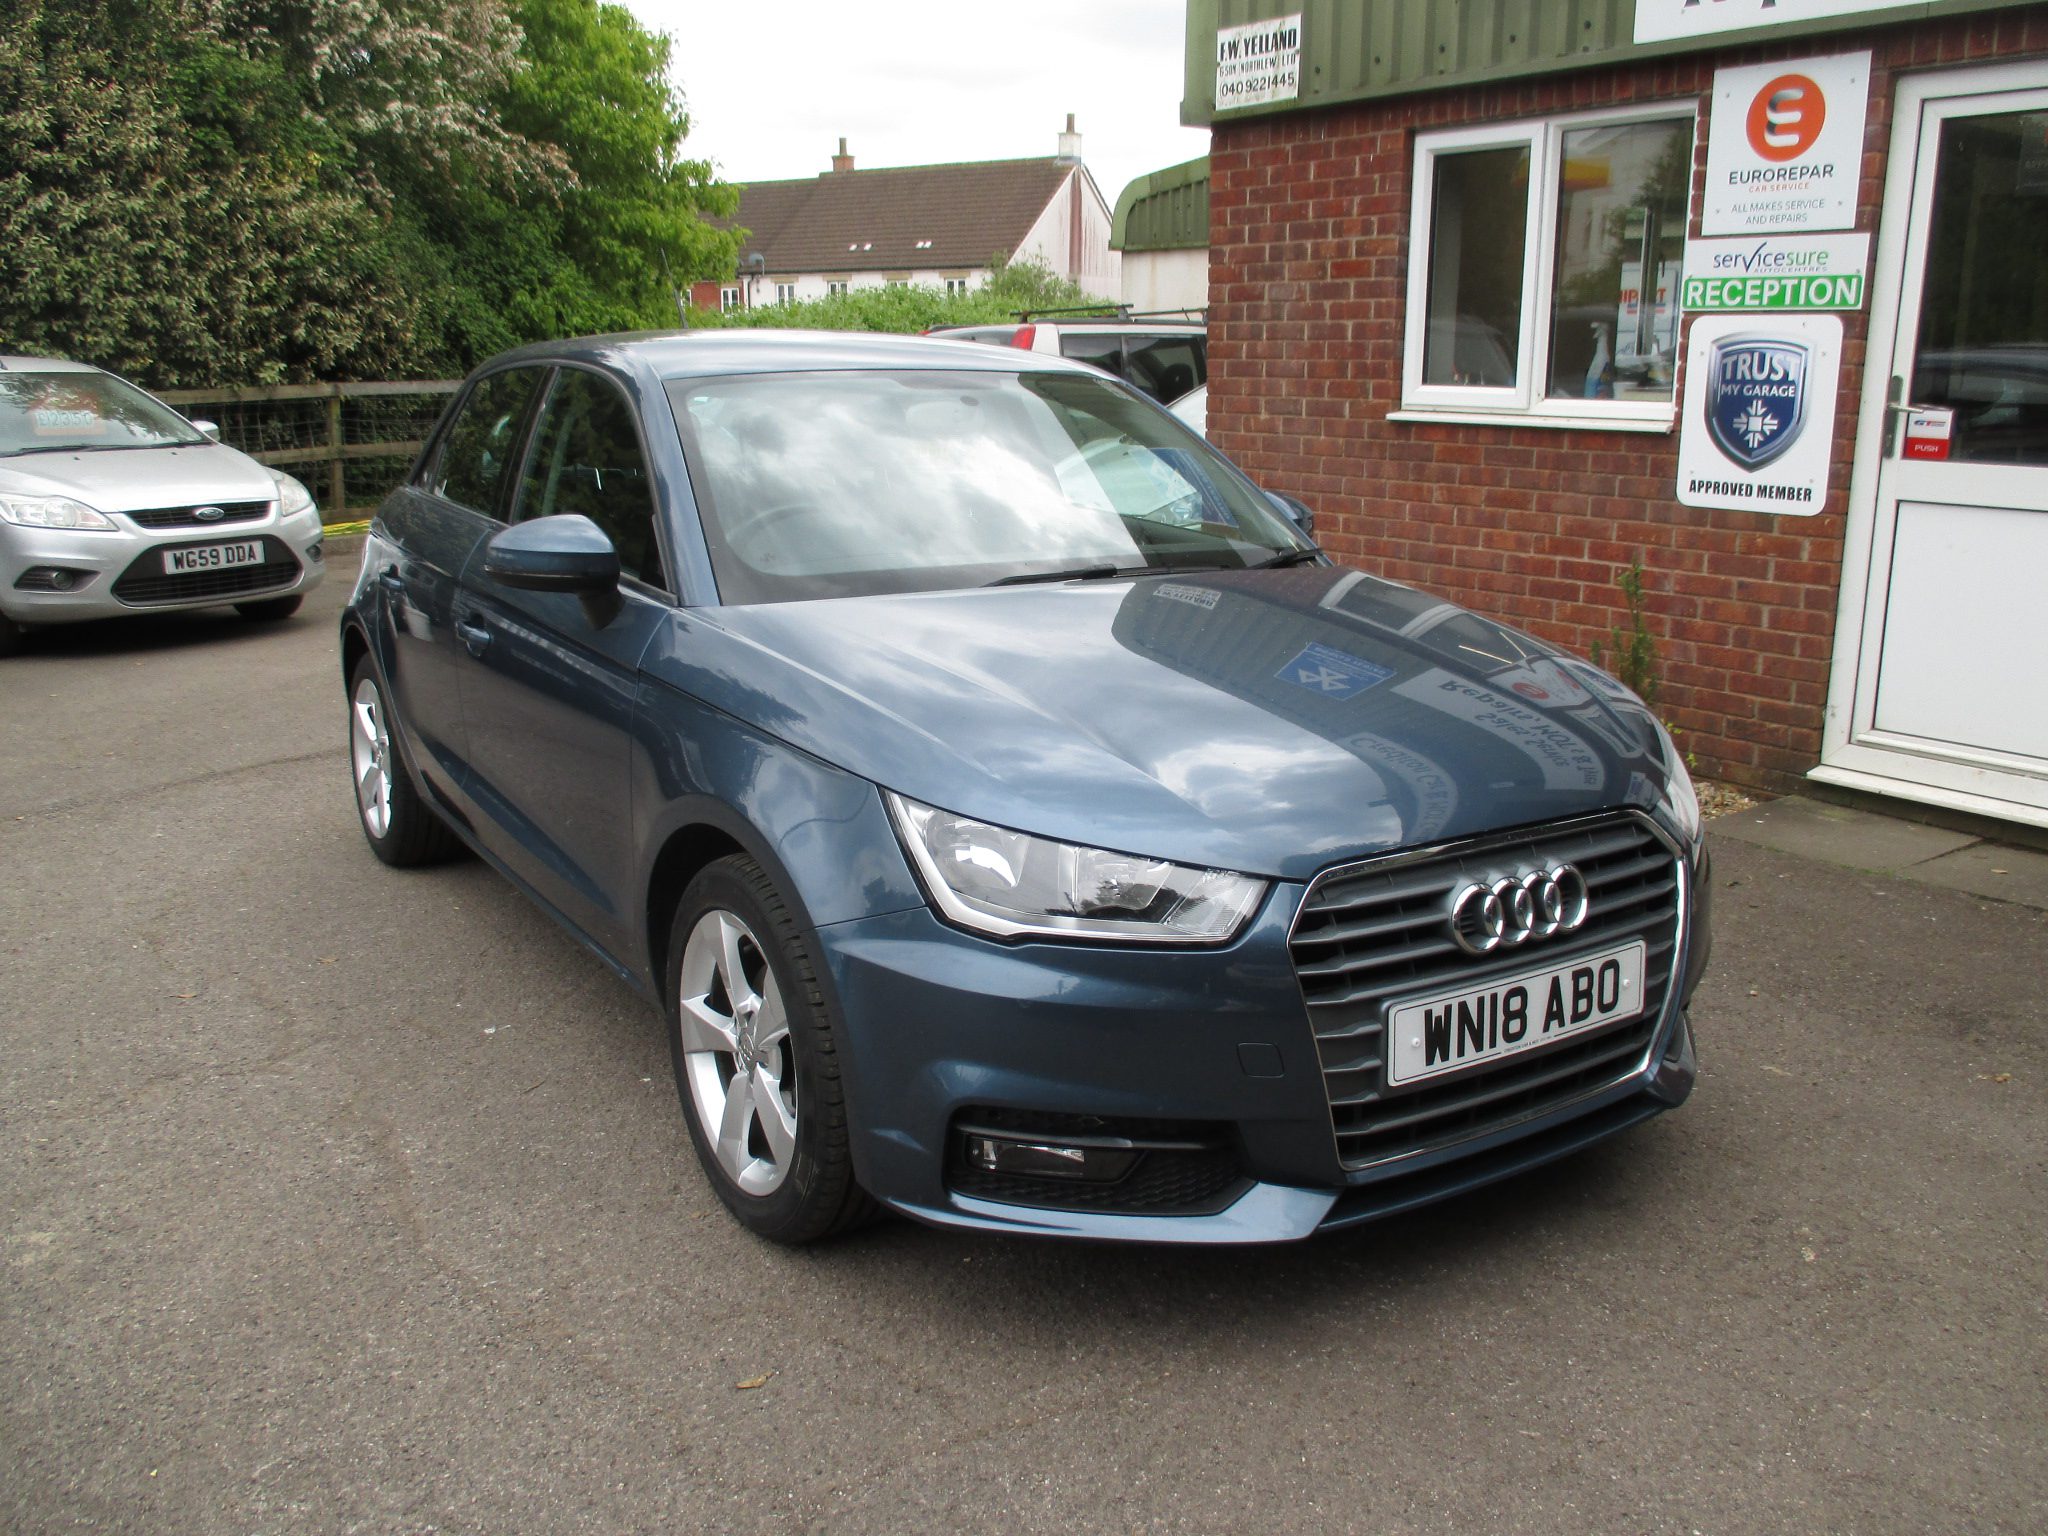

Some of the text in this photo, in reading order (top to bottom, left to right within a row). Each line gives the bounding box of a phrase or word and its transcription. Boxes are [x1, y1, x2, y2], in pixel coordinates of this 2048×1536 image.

[1243, 28, 1297, 57] YELLAND
[1728, 164, 1834, 185] EUROREPAR
[1749, 181, 1810, 193] CAR SERVICE
[1731, 198, 1826, 213] ALL MAKES SERVICE
[1745, 212, 1808, 225] AND REPAIRS
[1686, 277, 1858, 307] RECEPTION
[1721, 351, 1801, 382] TRUST
[1720, 383, 1796, 398] MY GARAGE
[1914, 444, 1939, 453] PUSH
[1688, 479, 1813, 502] APPROVED MEMBER
[173, 544, 257, 570] WG59 DDA
[1424, 958, 1620, 1067] WN18 ABO
